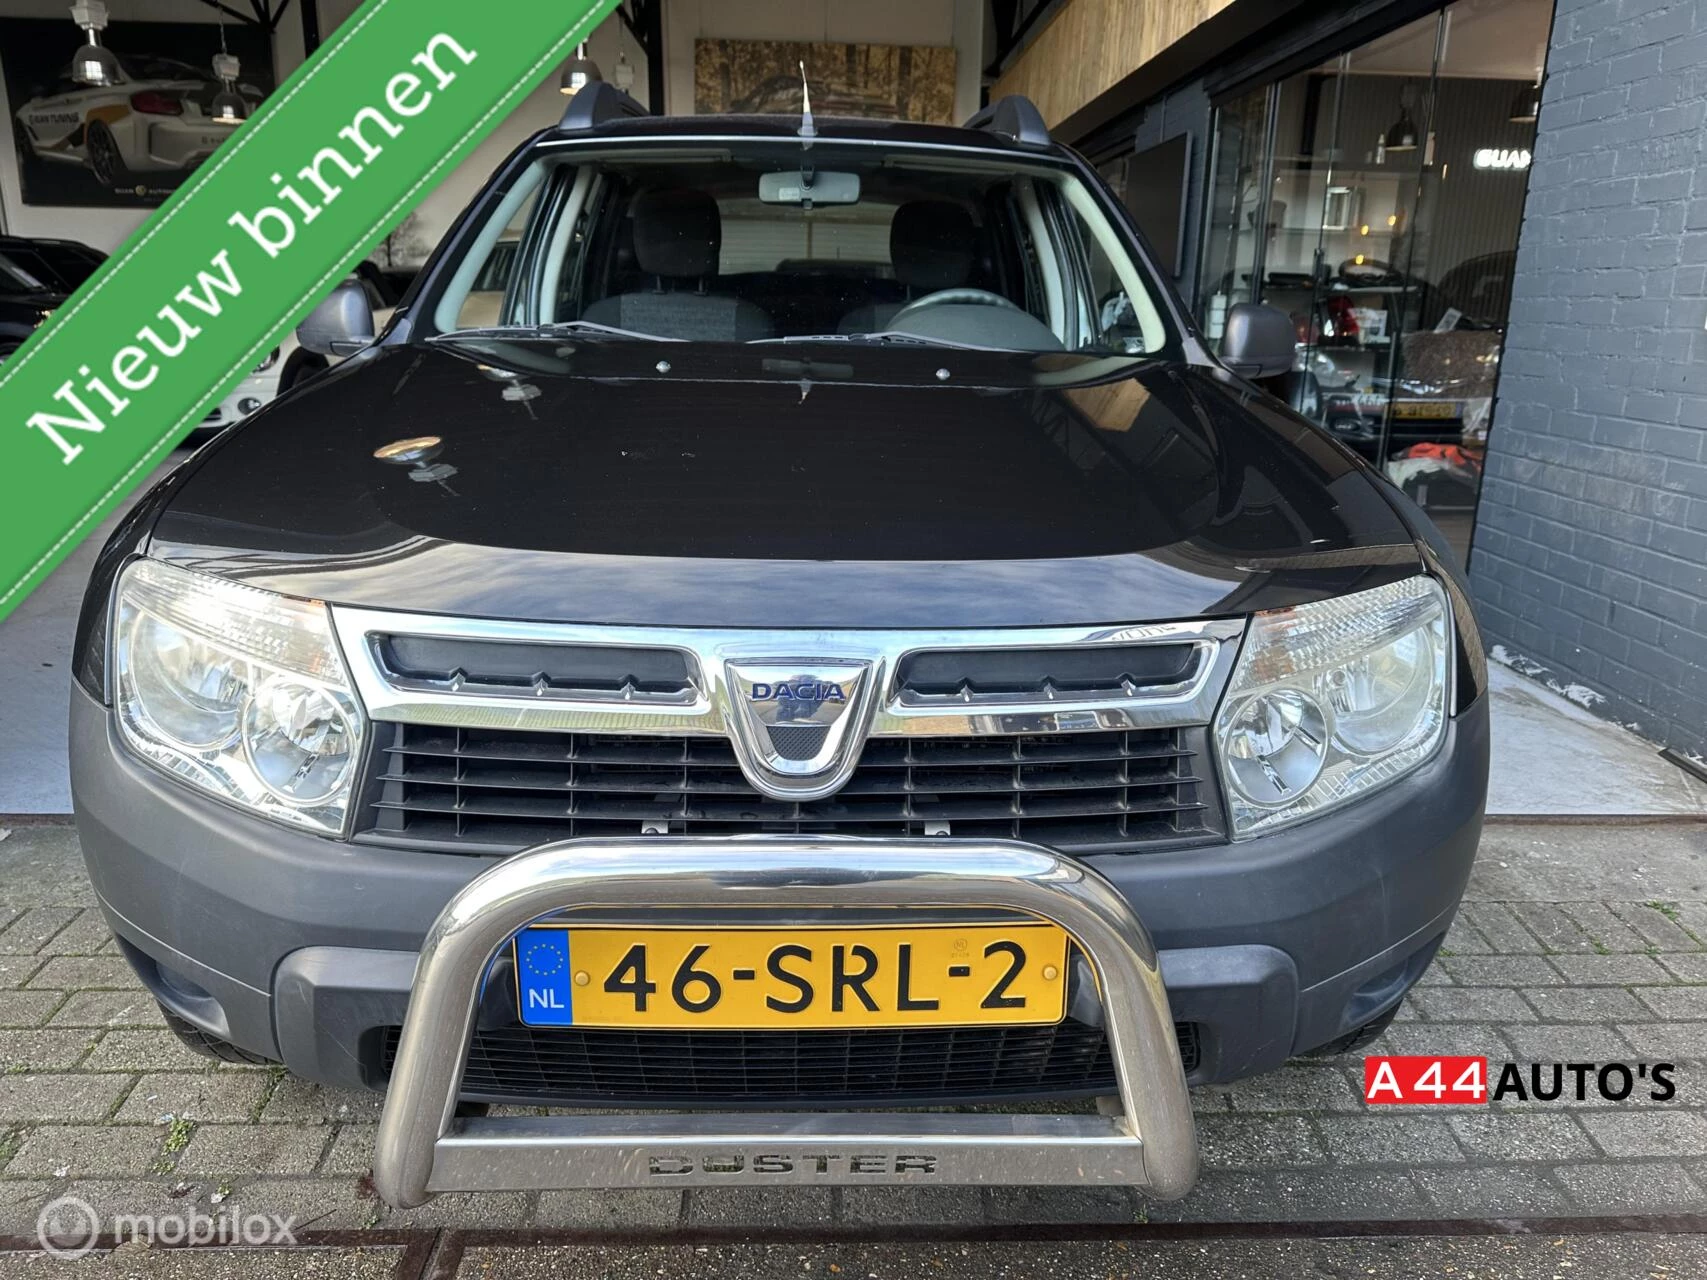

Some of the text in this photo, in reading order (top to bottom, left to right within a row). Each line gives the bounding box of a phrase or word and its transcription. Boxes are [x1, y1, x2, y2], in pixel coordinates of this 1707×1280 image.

[752, 683, 846, 700] DACIA
[602, 940, 1028, 1012] 46-SRL-2
[528, 988, 565, 1008] NL
[649, 1154, 937, 1177] DUSTER
